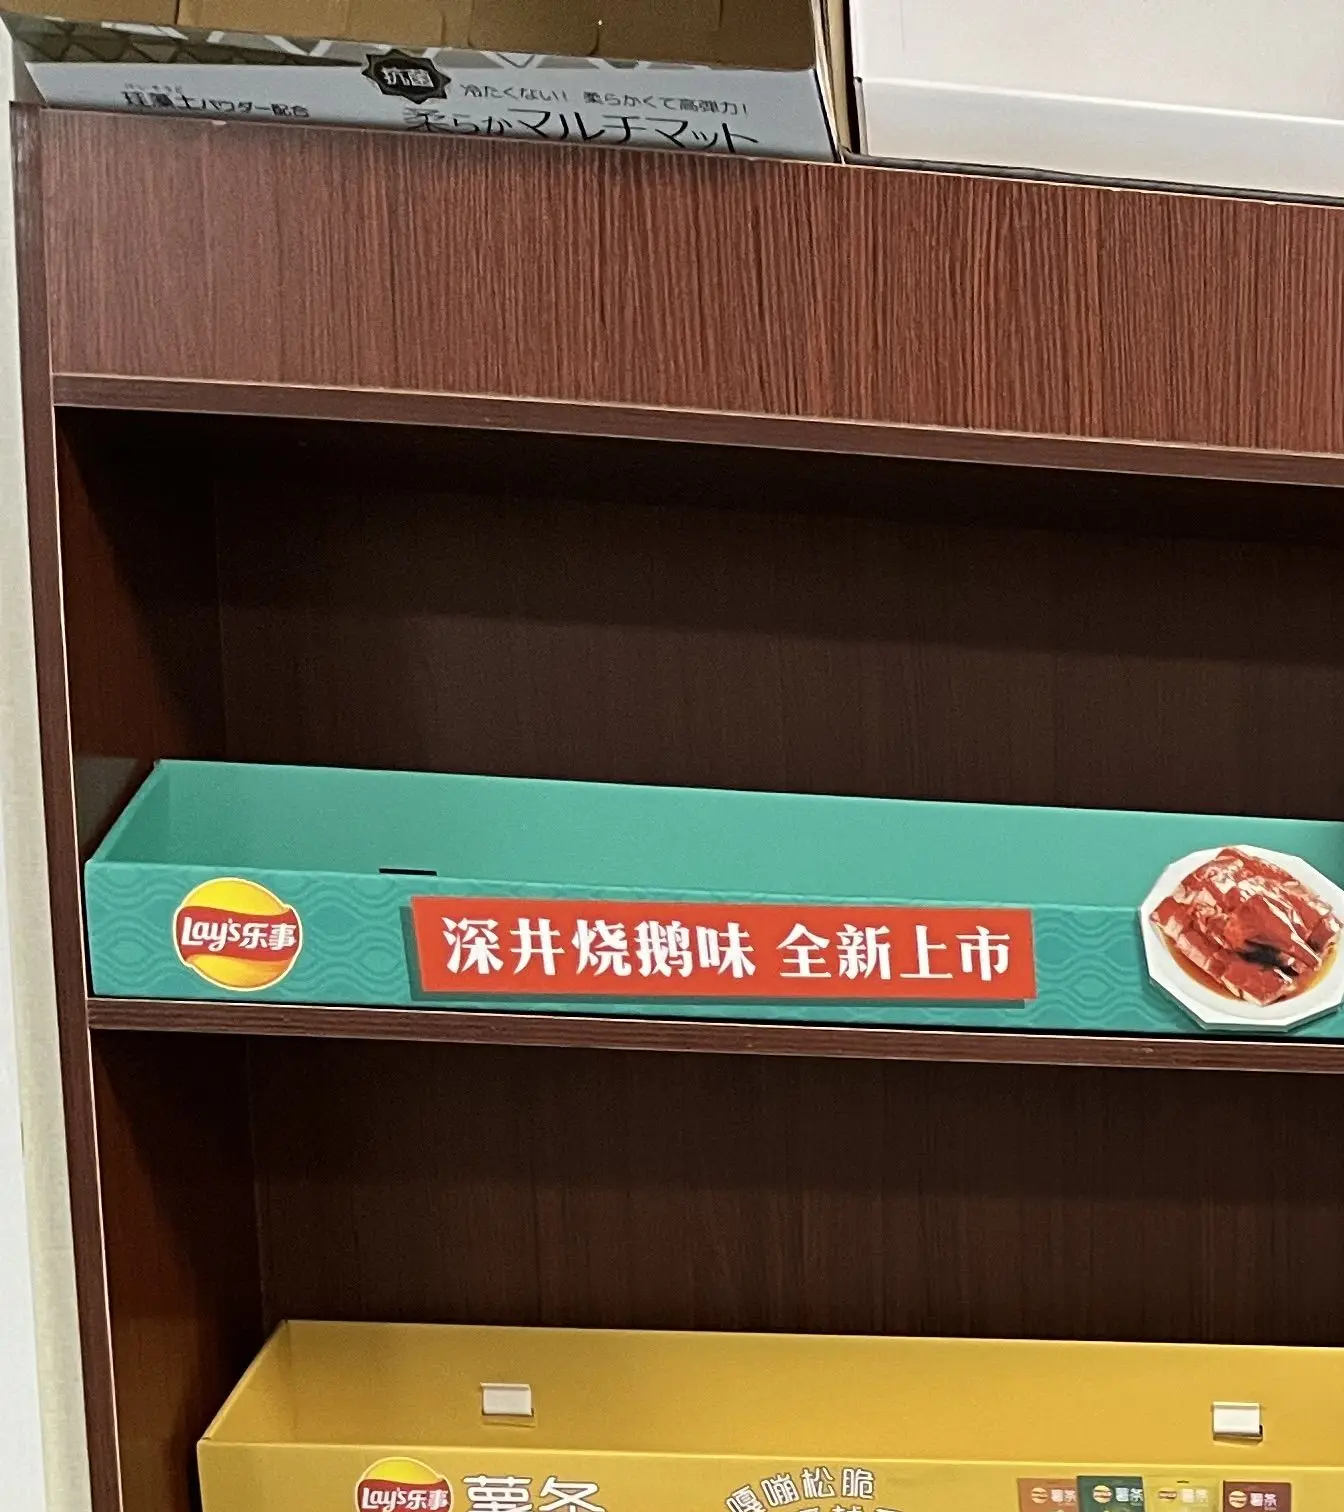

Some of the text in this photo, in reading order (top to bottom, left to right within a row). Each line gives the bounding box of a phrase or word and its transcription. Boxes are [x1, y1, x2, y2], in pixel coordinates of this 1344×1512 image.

[443, 915, 1011, 982] 深井烧鹅味 全新上市
